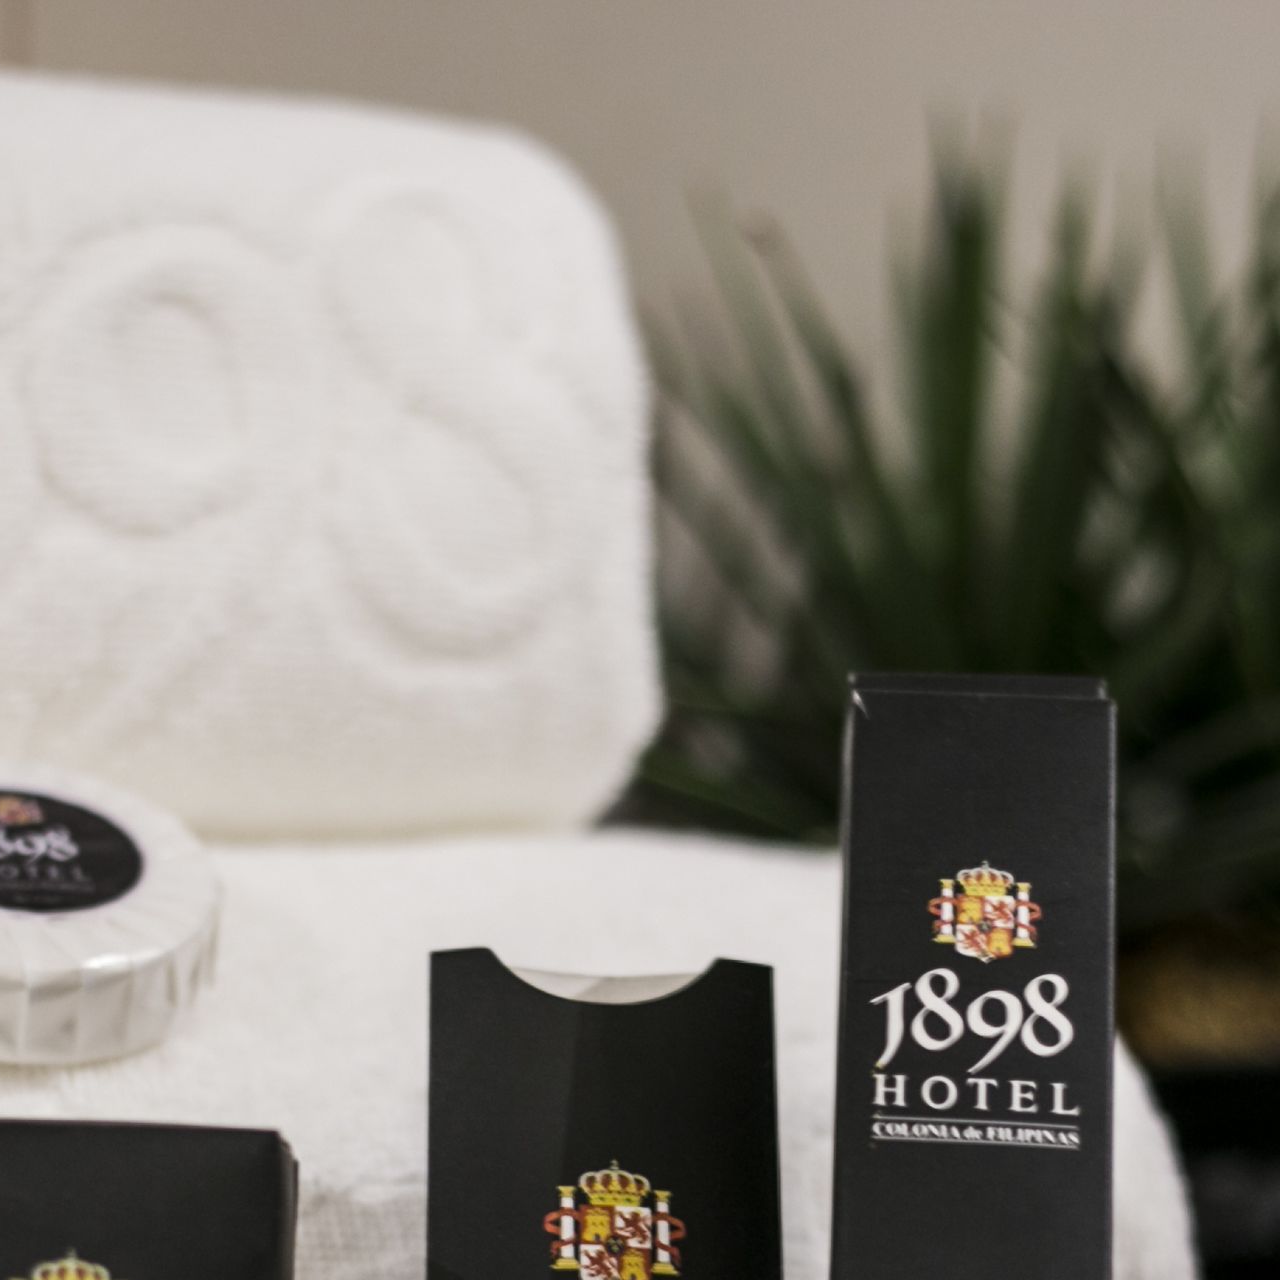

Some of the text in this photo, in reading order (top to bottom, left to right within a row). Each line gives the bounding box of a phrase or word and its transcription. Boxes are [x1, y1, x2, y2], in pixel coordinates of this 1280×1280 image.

[870, 967, 1074, 1074] 1898
[873, 1073, 1080, 1116] HOTEL
[872, 1121, 961, 1140] COLONIA
[986, 1125, 1080, 1146] FILIPINAS
